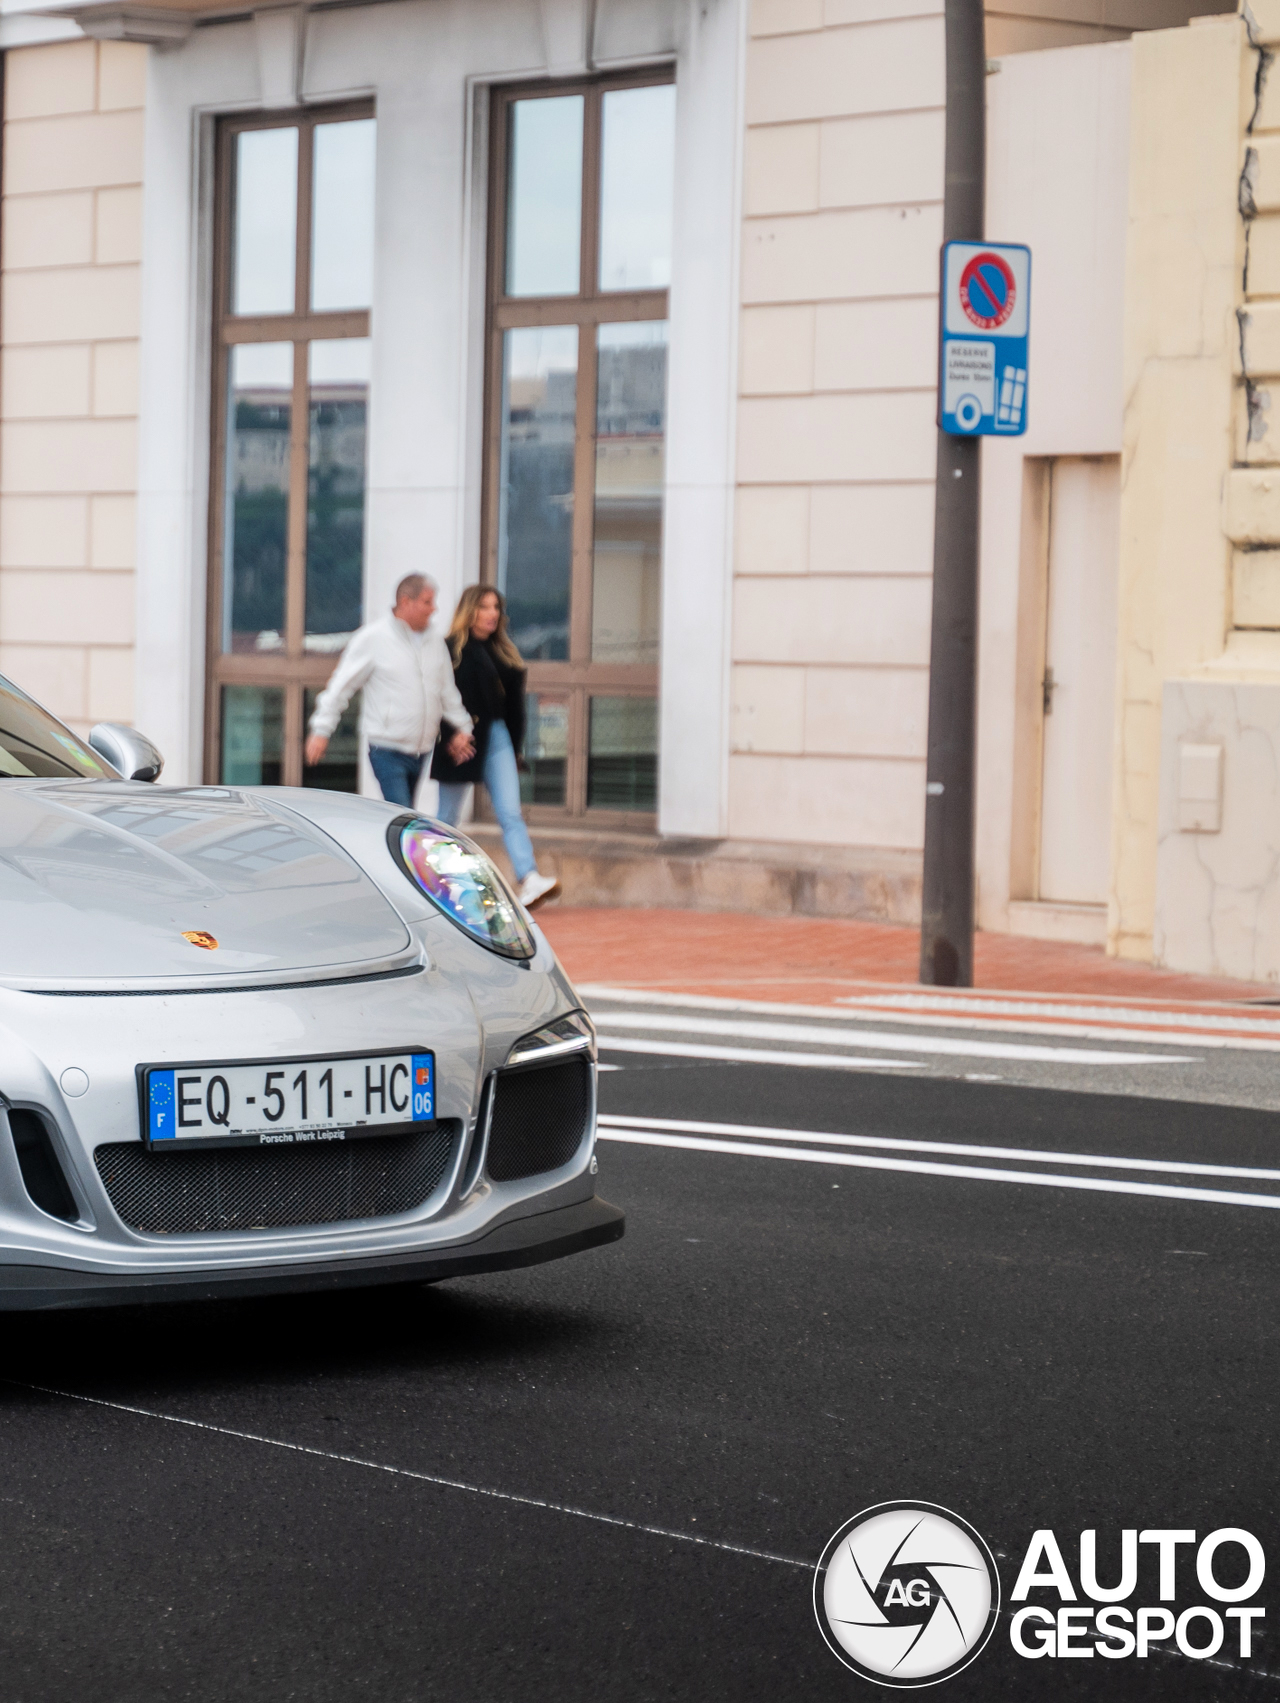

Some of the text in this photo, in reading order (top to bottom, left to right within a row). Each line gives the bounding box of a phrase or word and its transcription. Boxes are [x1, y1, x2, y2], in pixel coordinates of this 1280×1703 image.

[177, 1063, 410, 1127] EQ-511-HC
[414, 1092, 431, 1114] 06
[157, 1113, 165, 1127] F
[260, 1130, 346, 1144] Porsche Werk Leipzig
